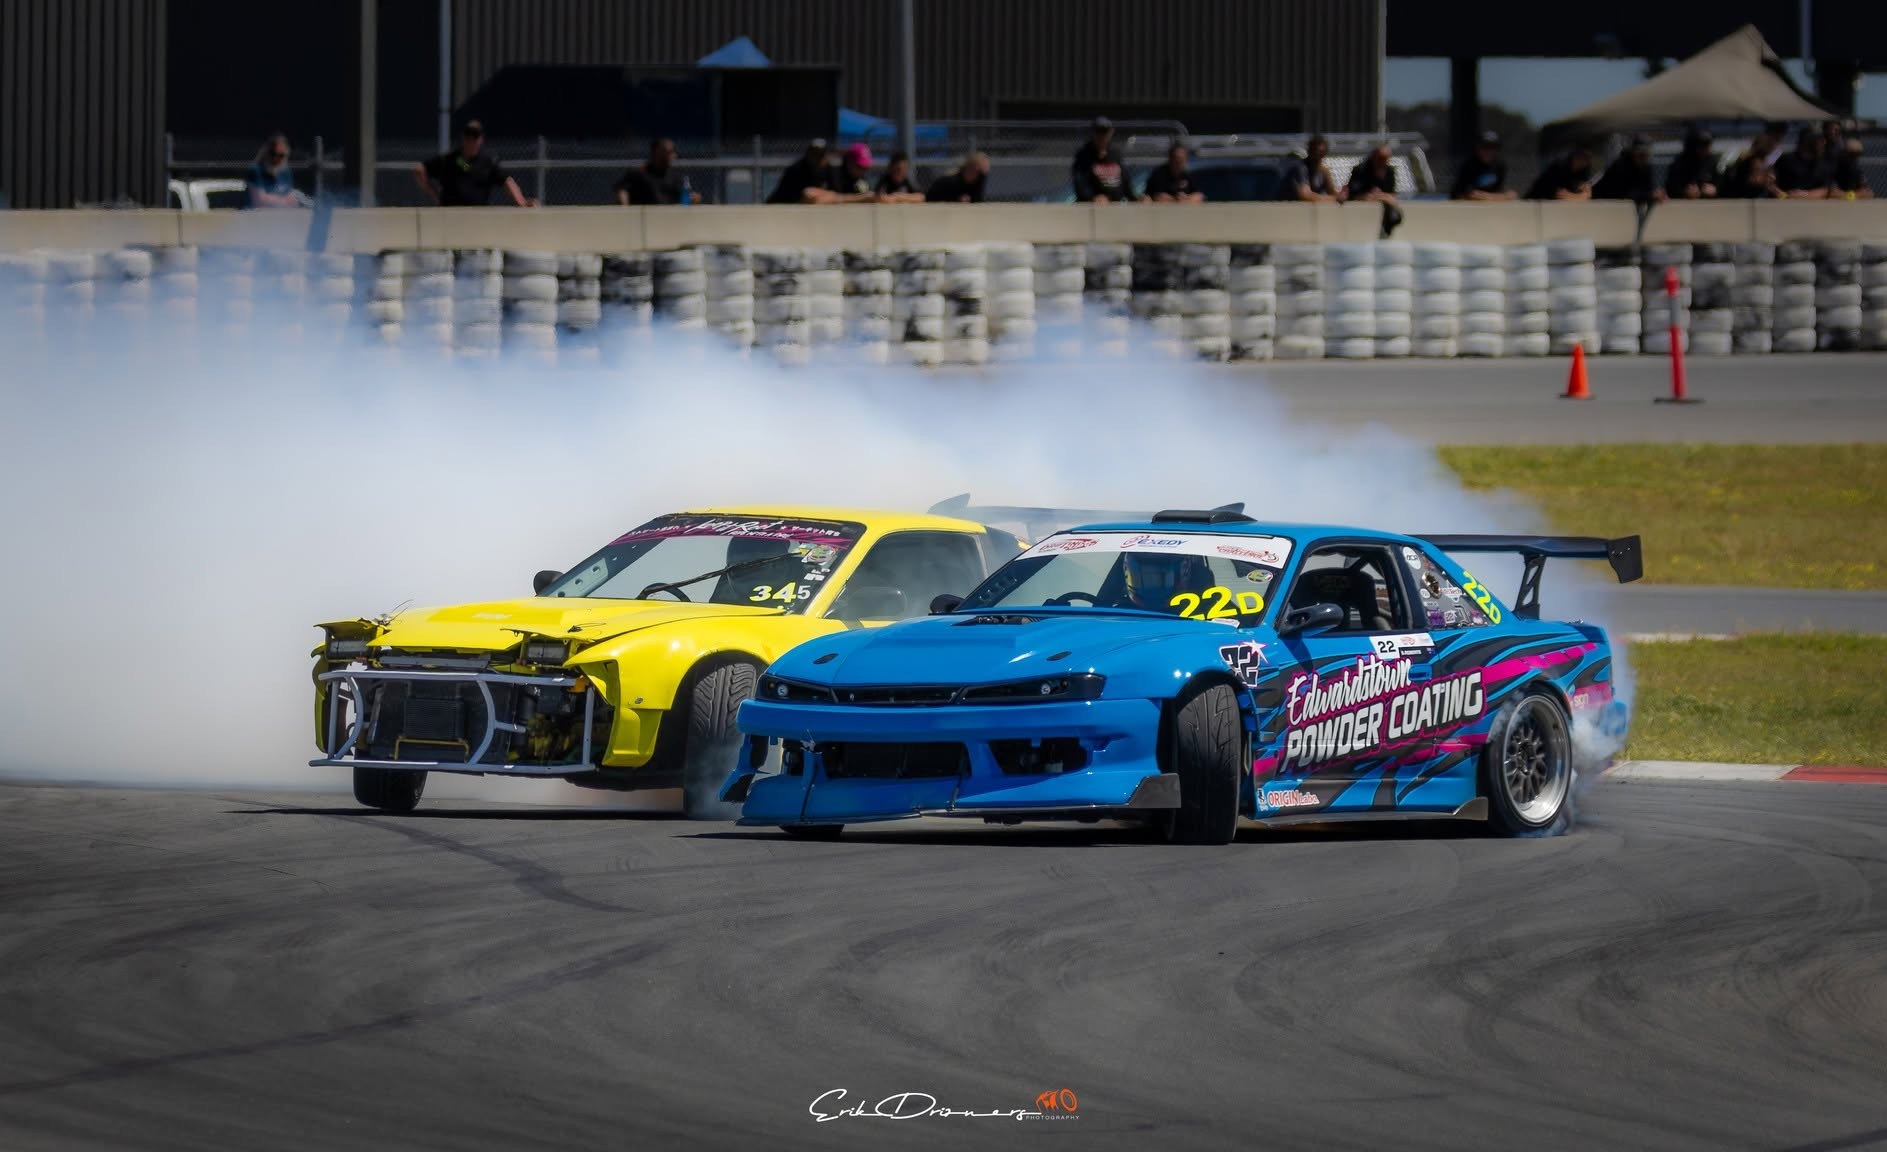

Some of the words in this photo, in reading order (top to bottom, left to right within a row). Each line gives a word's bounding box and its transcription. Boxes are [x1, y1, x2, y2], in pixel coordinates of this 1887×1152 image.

[1137, 538, 1187, 546] EXEDY
[1169, 586, 1264, 621] 22D
[1463, 571, 1501, 625] 22D
[1377, 640, 1397, 654] 22
[1287, 654, 1412, 726] Edwardstown
[1280, 702, 1385, 770] POWDER
[1388, 672, 1484, 739] COATING
[1267, 789, 1299, 807] ORIGIN
